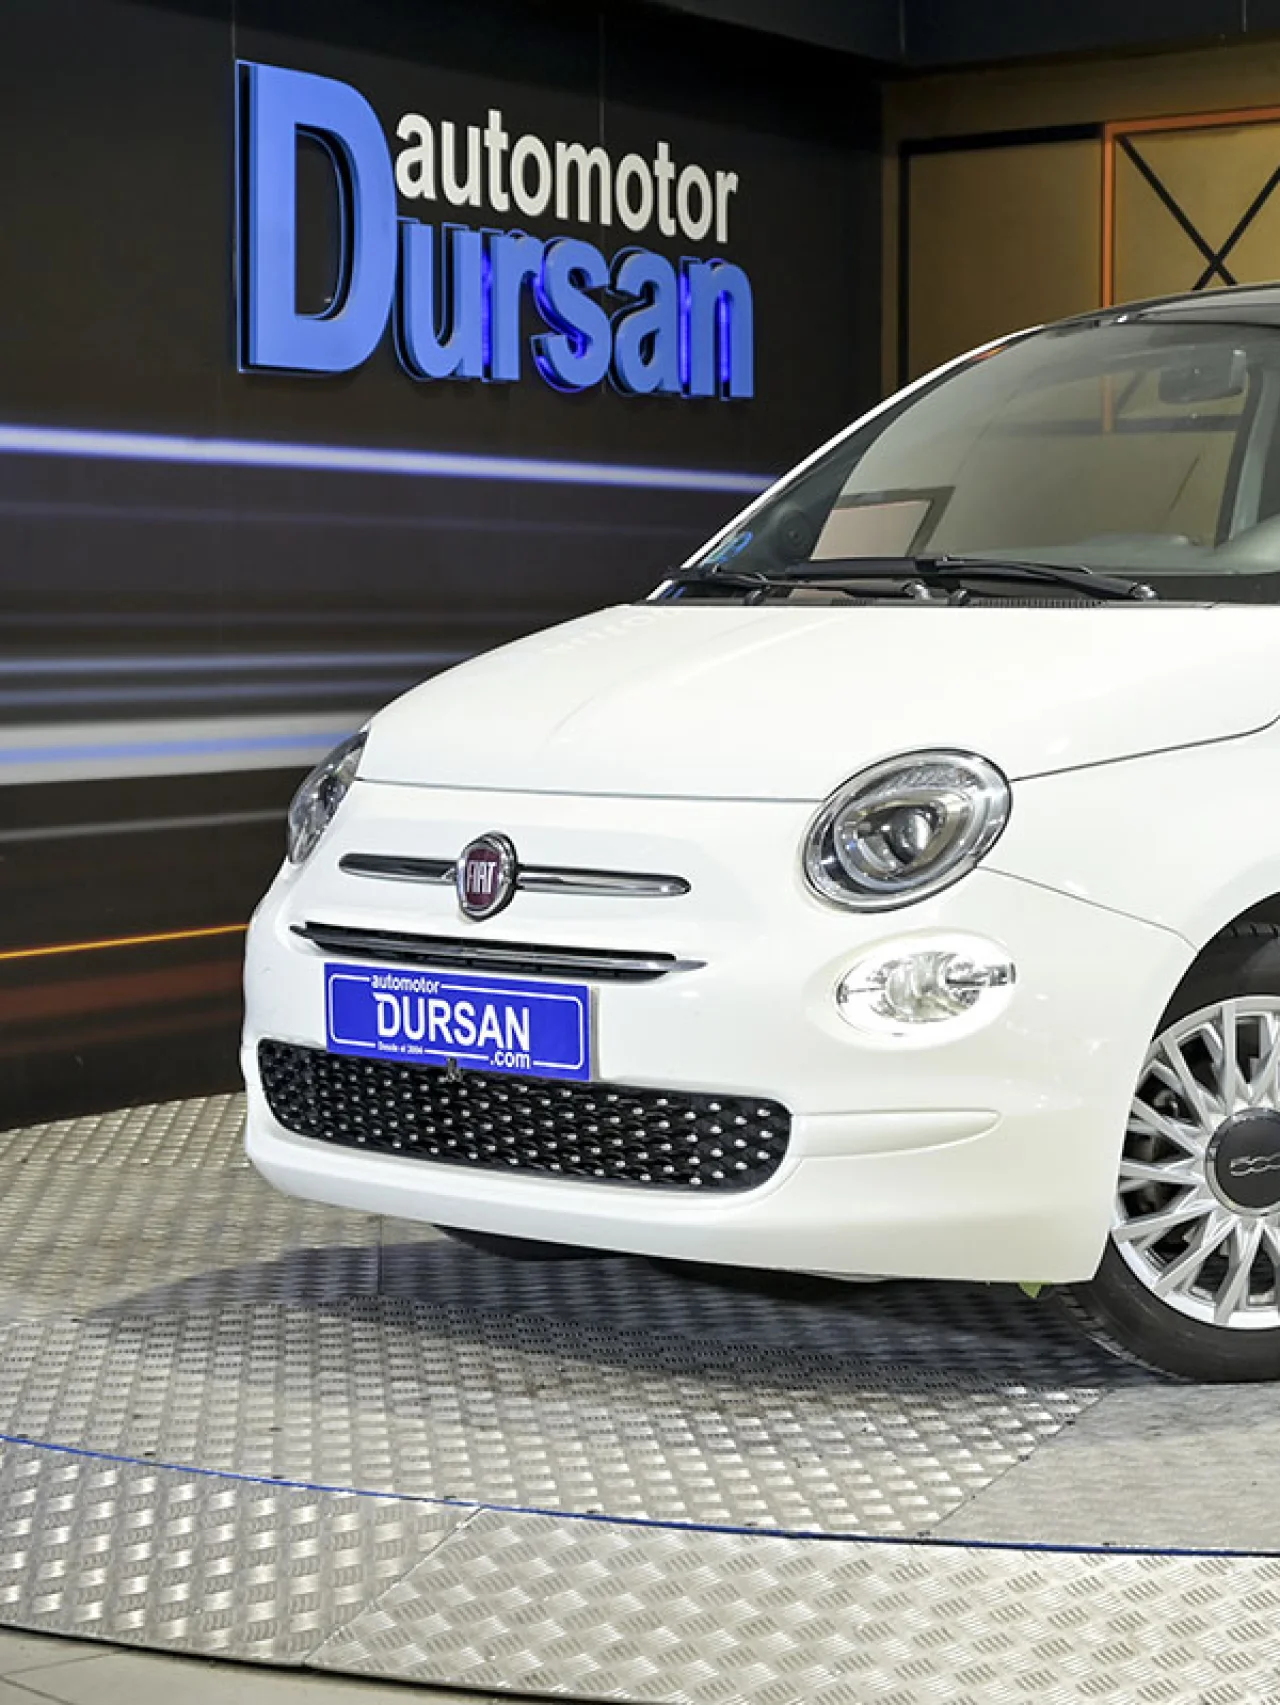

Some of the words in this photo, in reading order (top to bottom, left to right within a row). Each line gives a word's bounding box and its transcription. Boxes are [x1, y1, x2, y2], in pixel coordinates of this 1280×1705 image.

[396, 108, 739, 244] automotor
[235, 59, 754, 401] Dursan
[467, 861, 498, 894] FIAT
[371, 973, 440, 994] automotor
[374, 992, 530, 1050] DURSAN
[490, 1050, 531, 1069] .com
